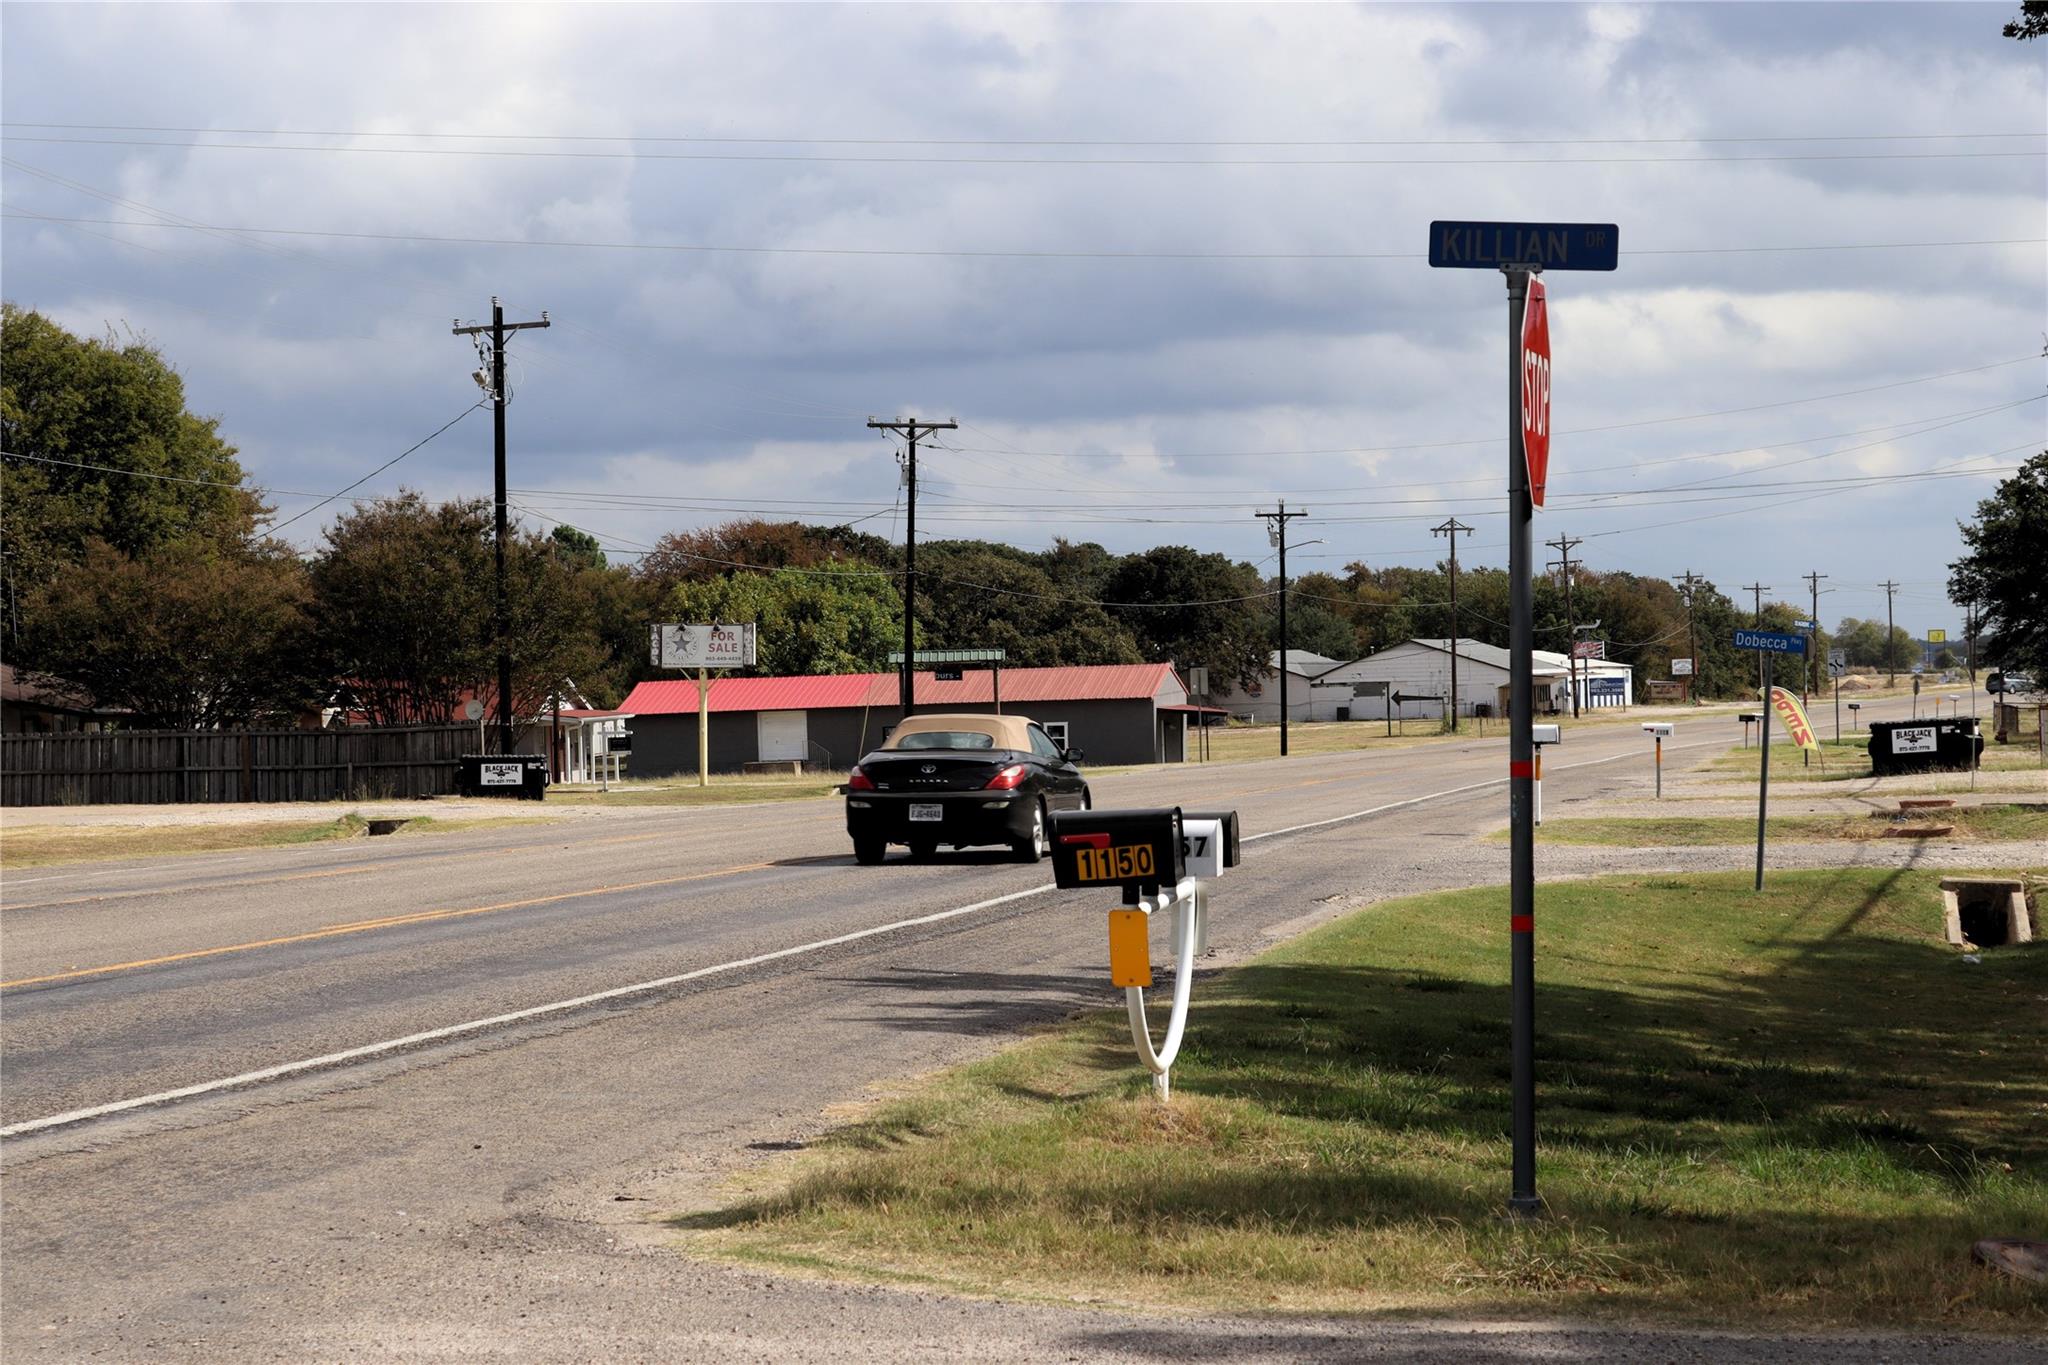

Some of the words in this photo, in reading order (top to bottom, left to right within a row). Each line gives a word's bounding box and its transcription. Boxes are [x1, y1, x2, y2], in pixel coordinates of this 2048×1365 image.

[1441, 228, 1568, 263] KILLIAN
[1585, 231, 1606, 248] DR
[1524, 348, 1549, 437] STOP
[708, 643, 738, 653] SALE
[710, 631, 735, 641] FOR
[1735, 632, 1788, 649] Dobecca
[1081, 846, 1151, 879] 1150
